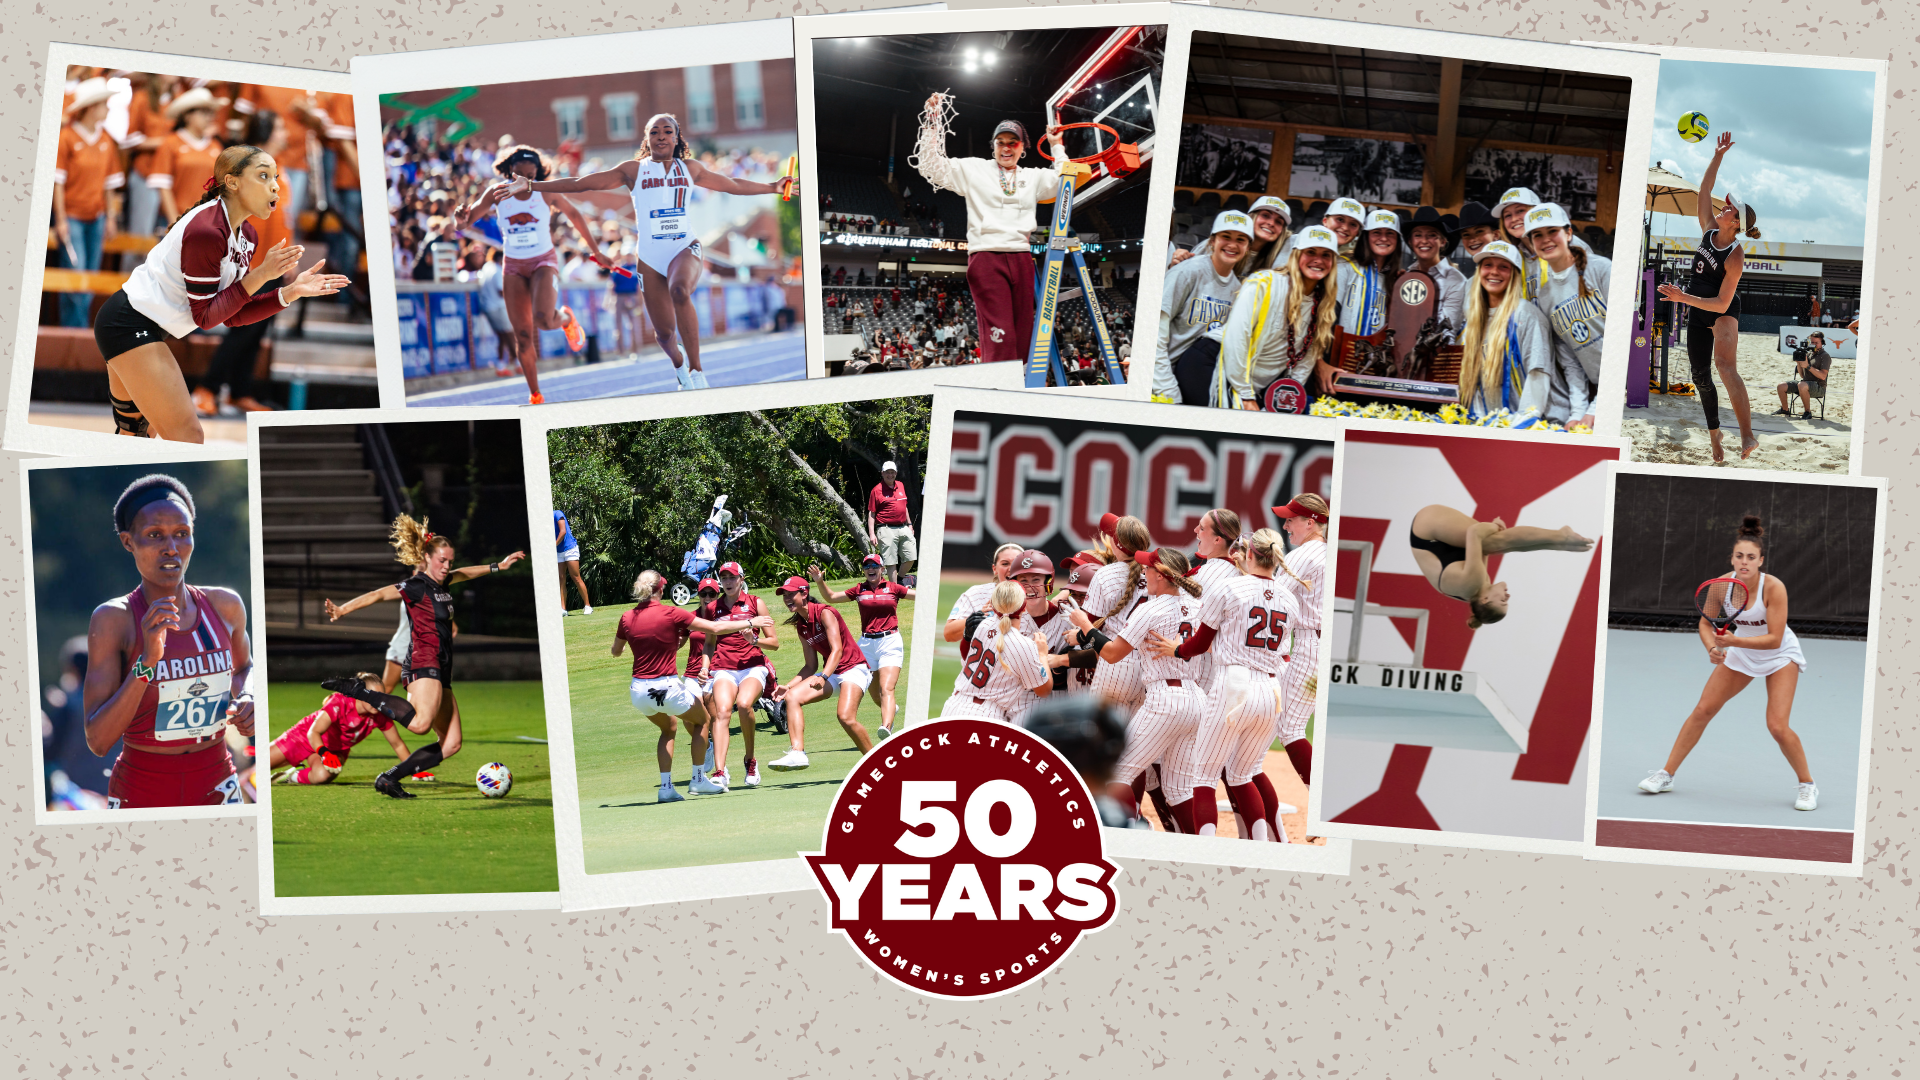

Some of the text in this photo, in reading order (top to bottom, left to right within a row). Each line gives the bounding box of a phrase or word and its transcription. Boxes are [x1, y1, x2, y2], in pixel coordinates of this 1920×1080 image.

[1060, 189, 1070, 221] WERNER
[836, 234, 908, 247] BIRMINGHAM
[909, 238, 956, 250] REGIONAL
[1042, 265, 1060, 321] BASKETBALL
[1088, 291, 1103, 323] PODIUM
[1401, 280, 1427, 305] SEC
[1571, 319, 1590, 344] SEC
[942, 421, 1335, 553] ECOCK
[1245, 606, 1288, 651] 25
[154, 649, 233, 681] AROLINA
[963, 637, 996, 689] 26
[1381, 667, 1464, 693] DIVING
[166, 694, 223, 730] 267
